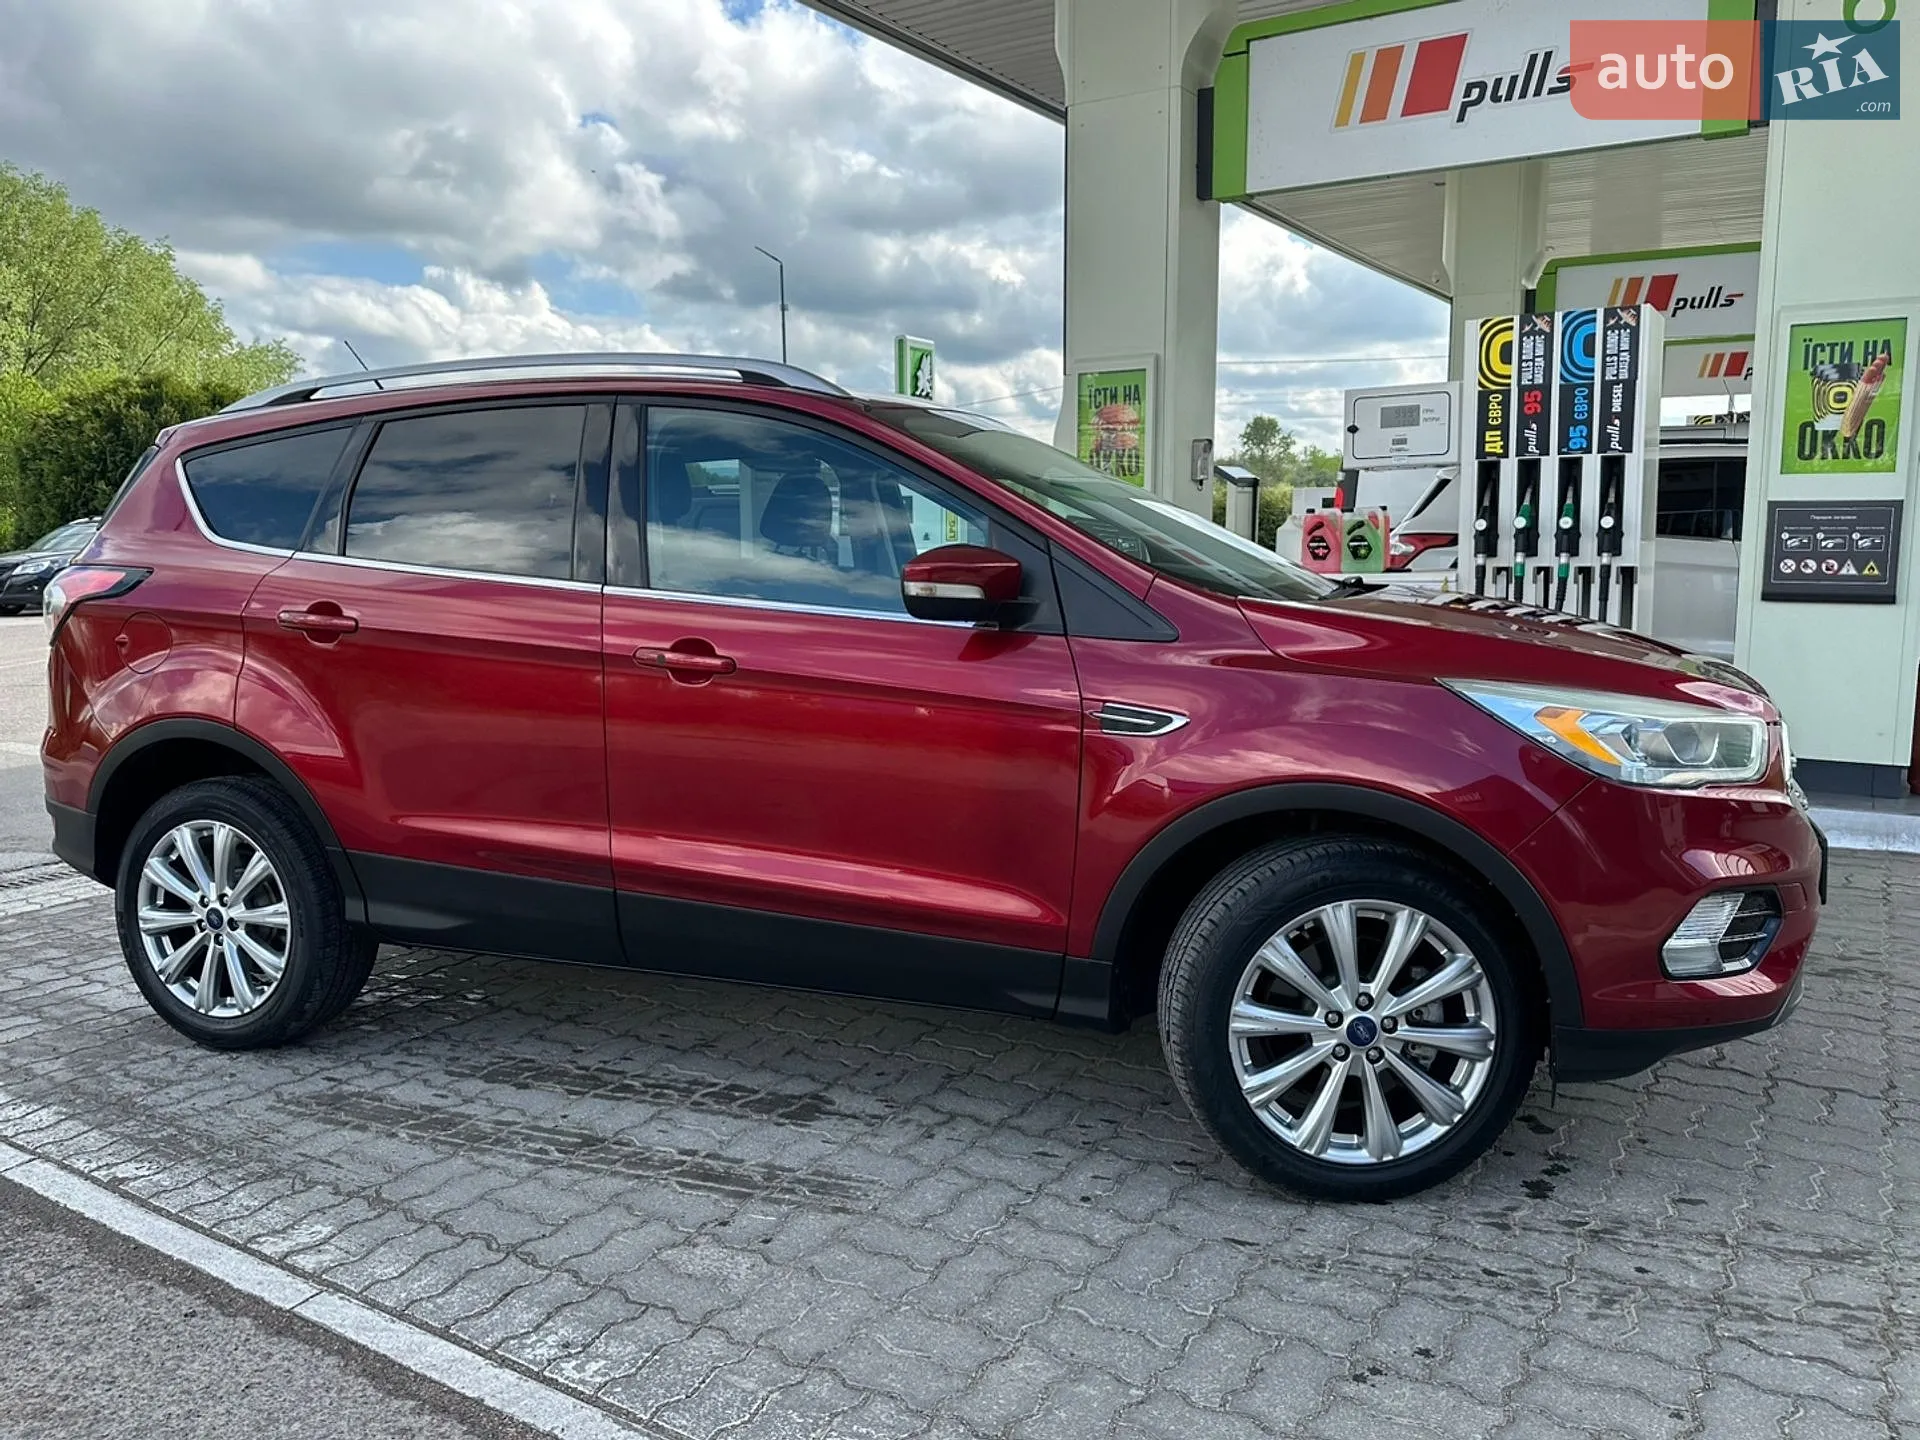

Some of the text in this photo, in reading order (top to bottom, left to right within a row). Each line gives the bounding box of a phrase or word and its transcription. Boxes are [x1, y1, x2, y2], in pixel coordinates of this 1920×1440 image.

[1455, 50, 1595, 123] pulls
[1671, 285, 1744, 318] pulls
[1523, 390, 1543, 453] pulls 95
[1569, 425, 1588, 450] 95
[1606, 383, 1623, 450] pulls DIESEL
[1484, 430, 1504, 454] ДП
